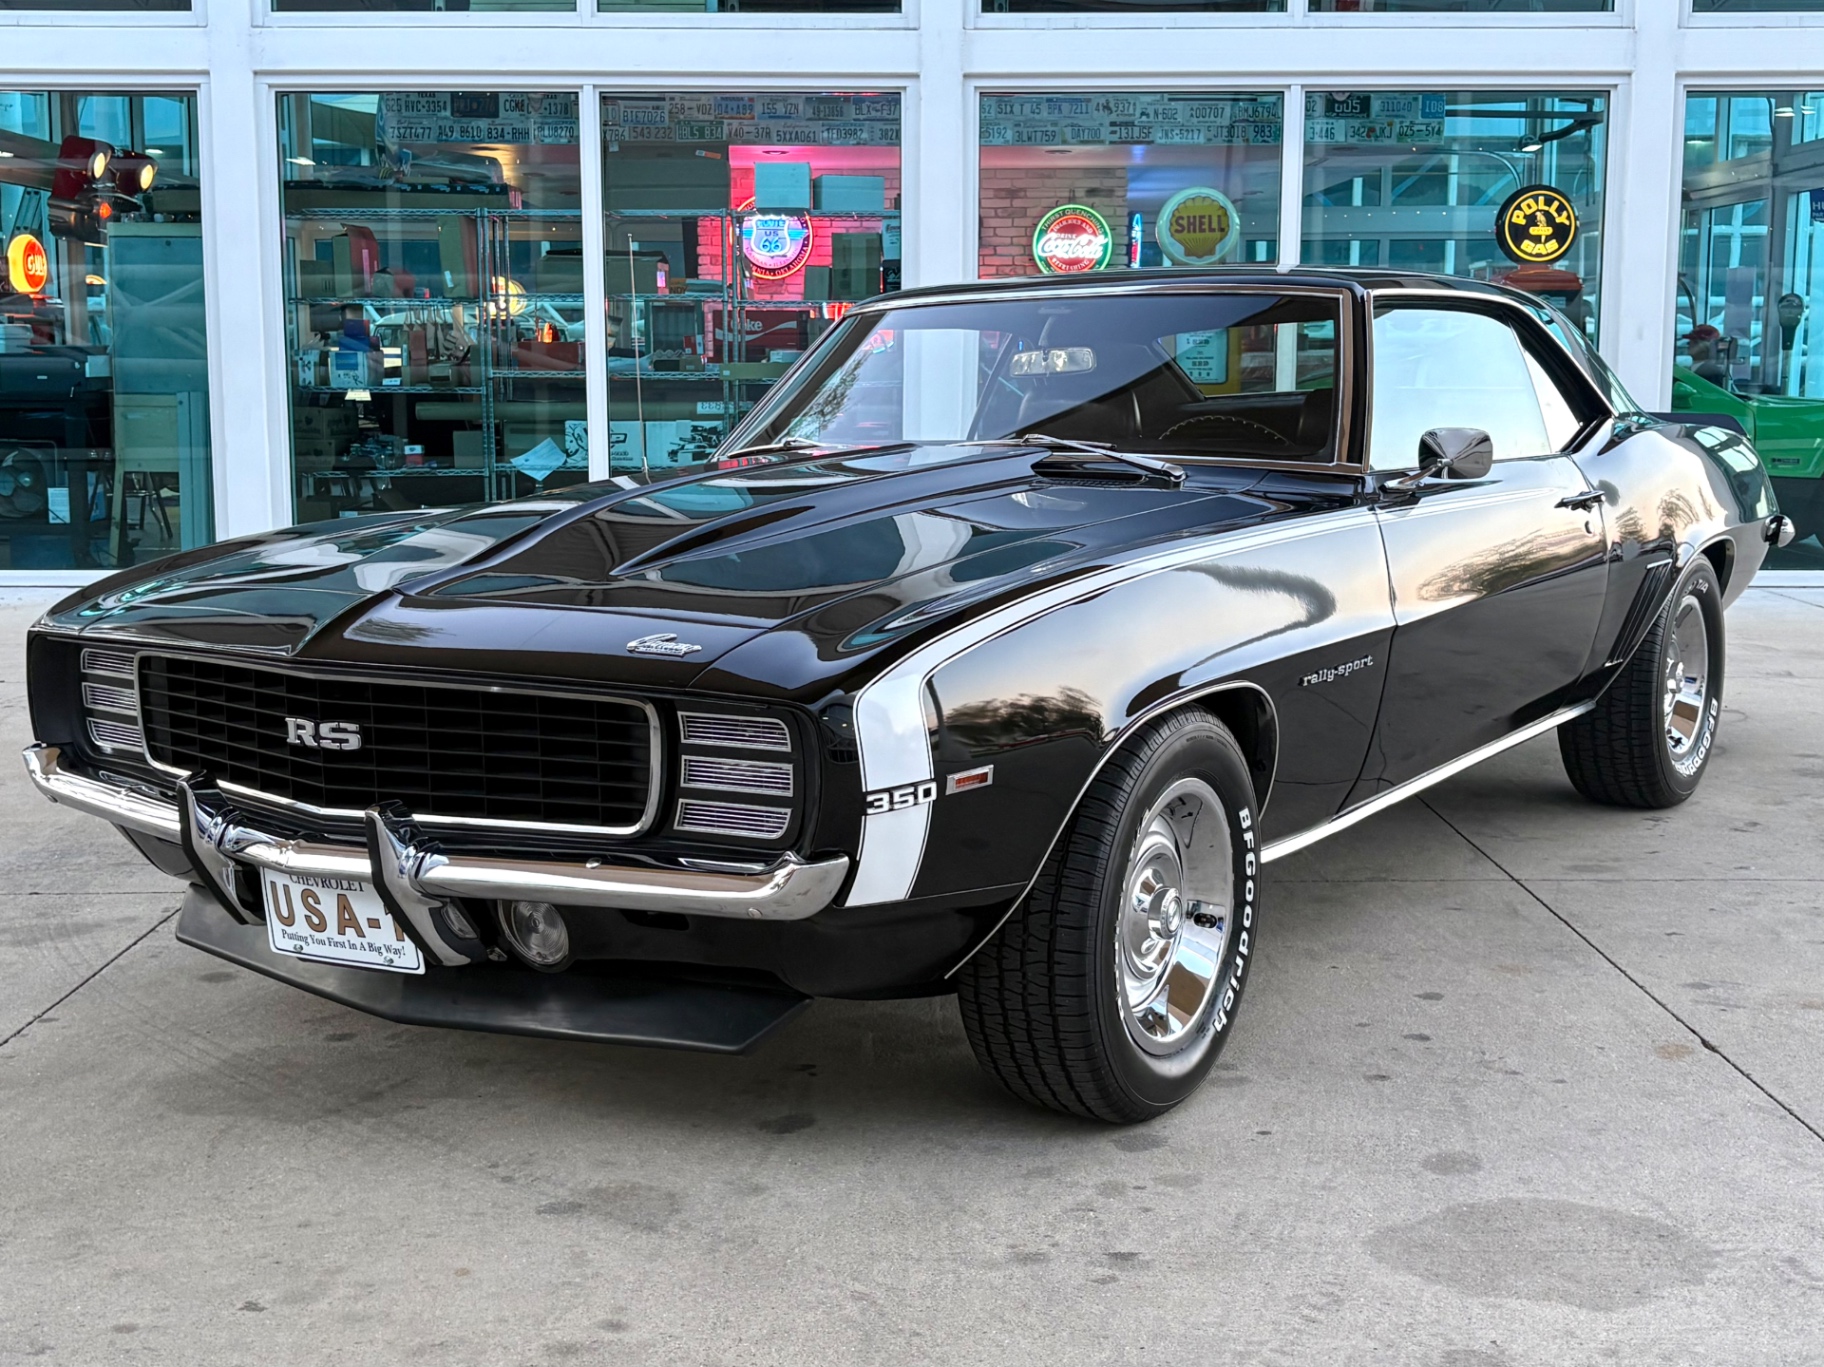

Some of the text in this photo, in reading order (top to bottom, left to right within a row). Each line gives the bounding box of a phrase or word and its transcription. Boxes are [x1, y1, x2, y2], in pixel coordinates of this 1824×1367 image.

[1042, 209, 1104, 233] THIRST QUENCHING
[1174, 215, 1225, 234] SHELL
[1512, 196, 1570, 226] POLLY
[760, 237, 782, 252] 66
[1521, 239, 1558, 255] GAS
[775, 247, 809, 276] OKLAHOMA
[1302, 655, 1374, 686] rally-sport
[285, 717, 361, 750] RS
[866, 781, 938, 815] 350
[289, 874, 364, 892] CHEVROLET
[1212, 806, 1257, 1034] BFGoodrich
[281, 928, 406, 961] Putting You First In A Big Way!
